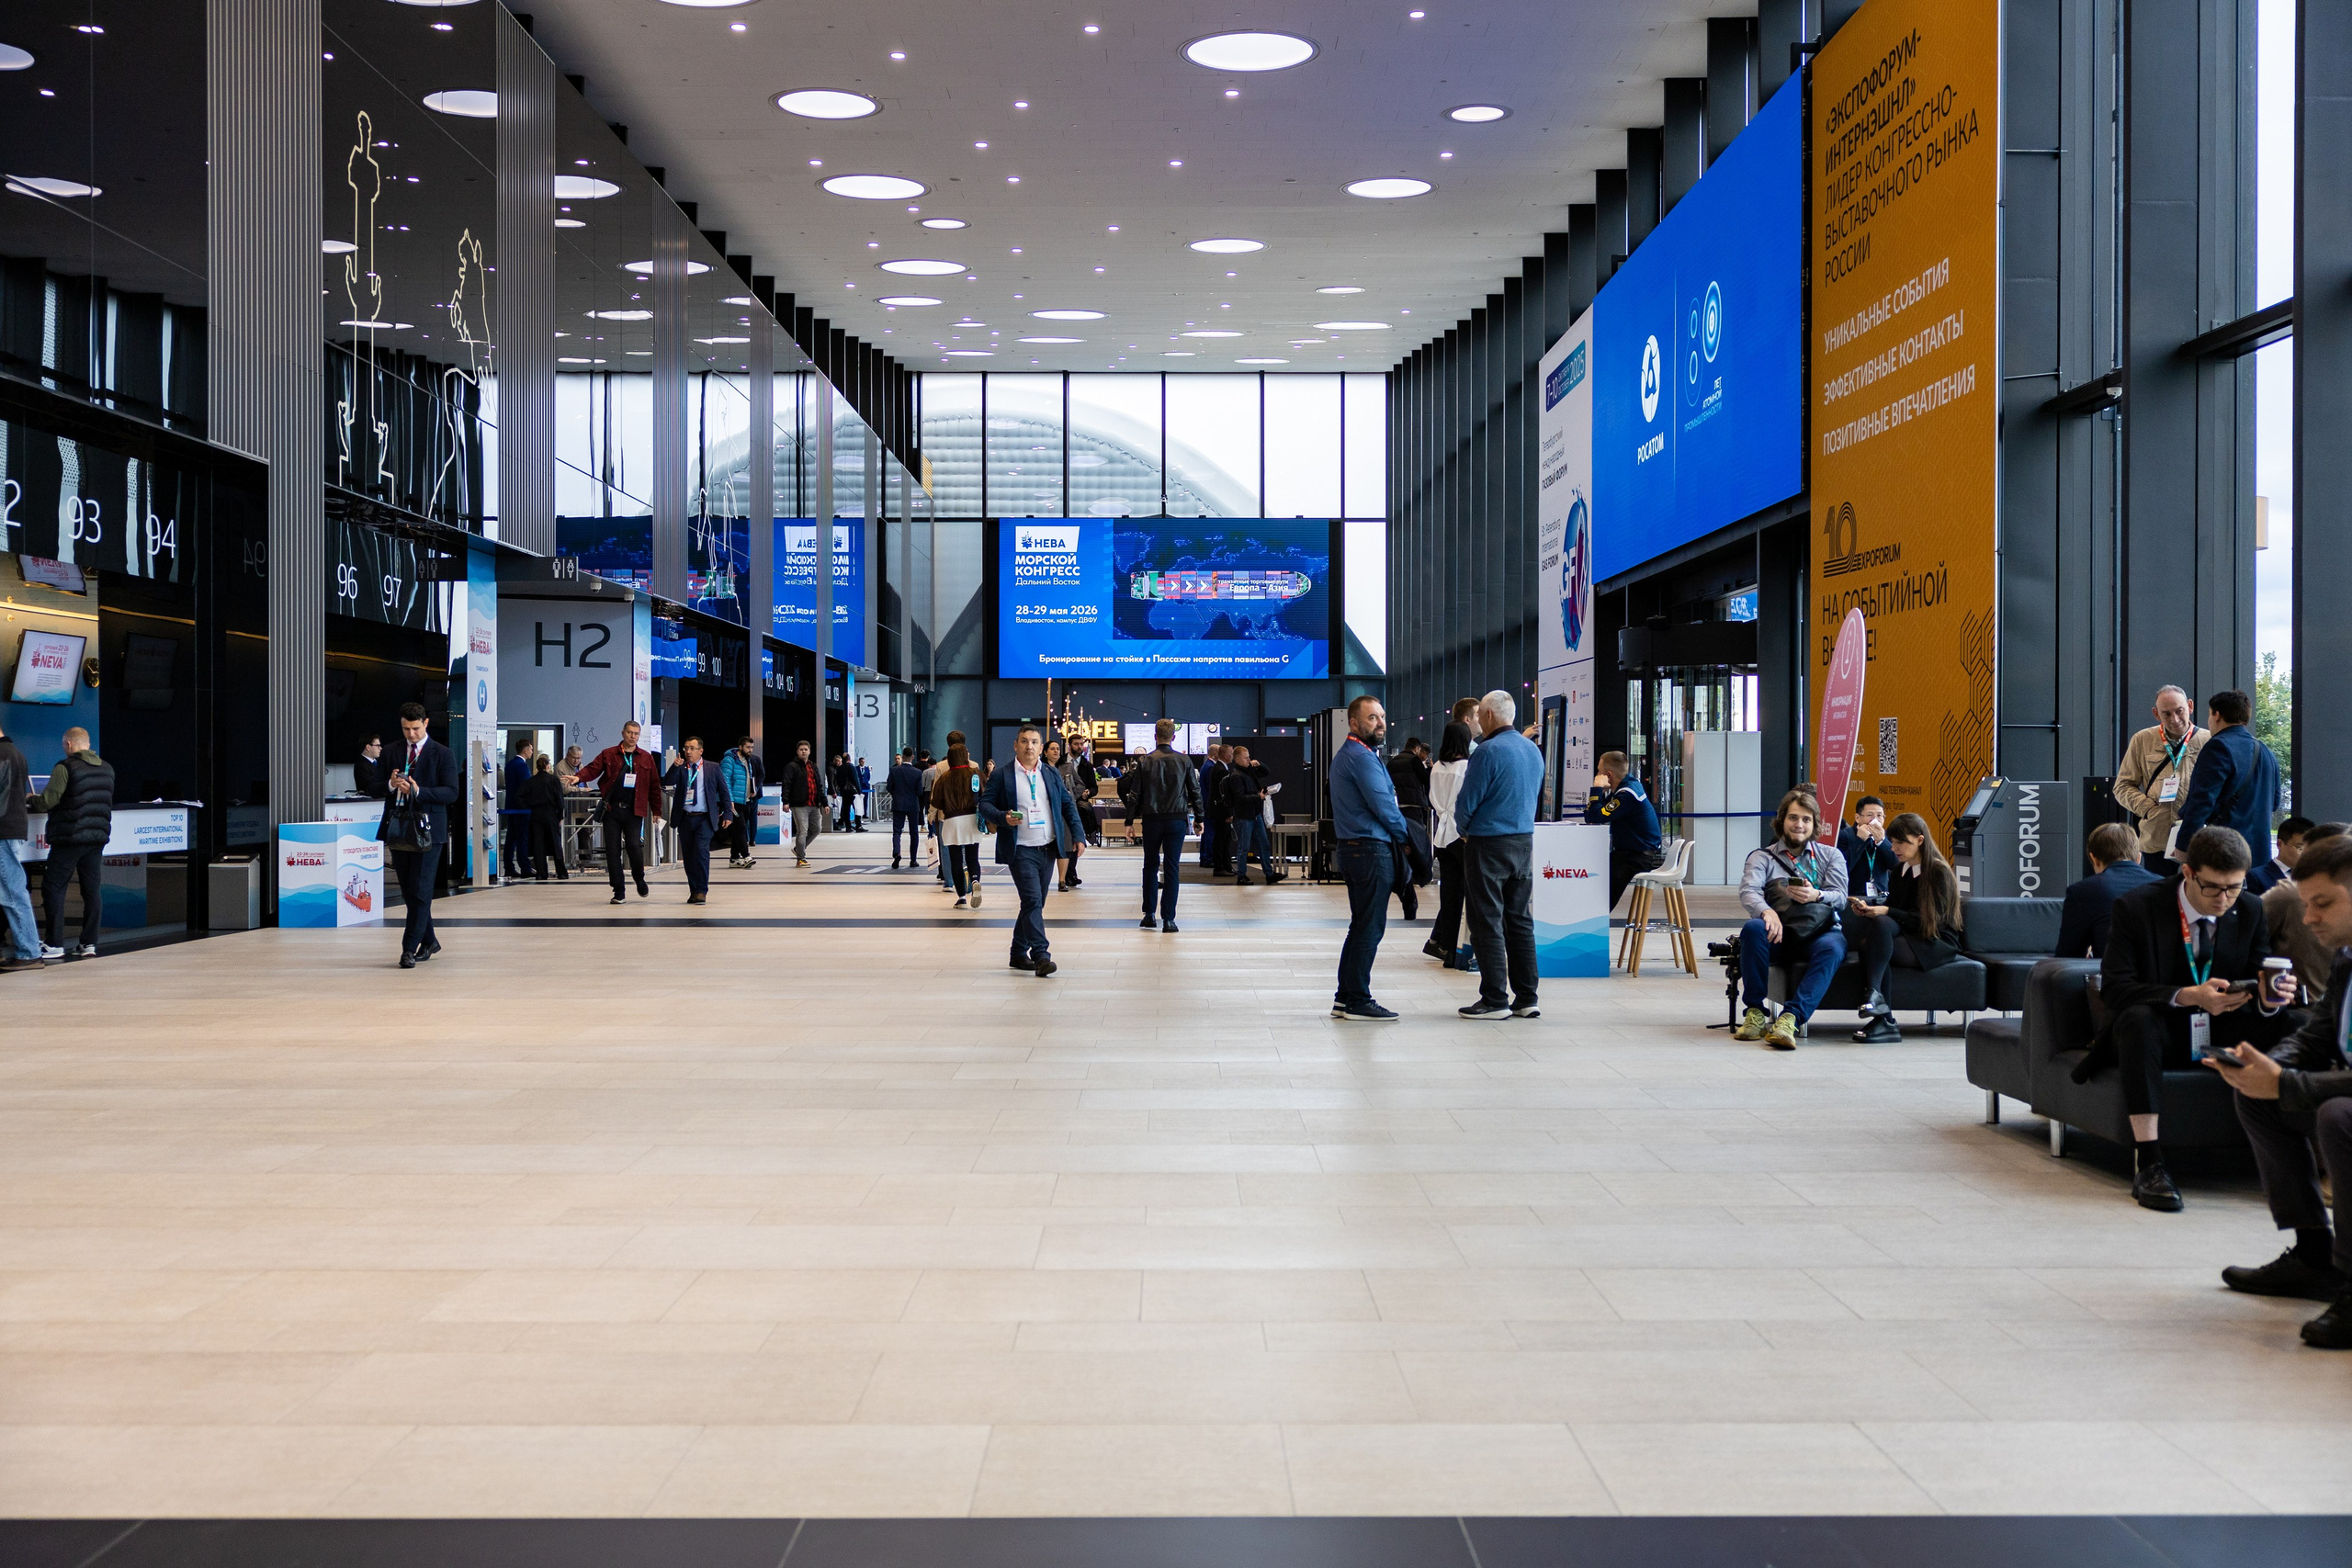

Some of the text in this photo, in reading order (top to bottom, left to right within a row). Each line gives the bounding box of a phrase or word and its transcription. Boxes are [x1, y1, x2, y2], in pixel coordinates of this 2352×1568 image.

[1825, 28, 1922, 134] «ЭКСПОФОРУМ-
[1825, 76, 1917, 176] ИНТЕРНЭШНЛ»
[1825, 85, 1958, 215] ЛИДЕР КОНГРЕССНО-
[1825, 107, 1979, 251] ВЫСТАВОЧНОГО РЫНКА
[1825, 231, 1871, 288] РОССИИ
[1824, 256, 1950, 355] УНИКАЛЬНЫЕ СОБЫТИЯ
[1824, 309, 1964, 405] ЭФФЕКТИВНЫЕ КОНТАКТЫ
[1546, 350, 1585, 406] 7-10 2025
[1713, 377, 1723, 390] ЛЕТ
[1702, 388, 1723, 411] АТОМНОЙ
[1823, 363, 1975, 457] ПОЗИТИВНЫЕ ВПЕЧАТЛЕНИЯ
[1683, 400, 1723, 434] ПРОМЫШЛЕННОСТИ
[1637, 431, 1665, 466] РОСАТОМ
[4, 479, 22, 528] 2
[66, 495, 102, 544] 93
[145, 513, 176, 558] 94
[1035, 539, 1066, 548] НЕВА
[1015, 553, 1076, 566] МОРСКОЙ
[1547, 553, 1559, 569] FORUM
[1853, 542, 1902, 571] EXPOFORUM
[337, 563, 357, 599] 96
[1015, 566, 1080, 576] КОНГРЕСС
[1015, 577, 1051, 586] Дальний
[383, 574, 401, 608] 97
[1229, 584, 1260, 592] Европа
[1823, 559, 1948, 626] НА СОБЫТИЙНОЙ
[1016, 606, 1047, 615] 28-29
[1070, 606, 1098, 615] 2026
[536, 621, 612, 669] H2
[40, 654, 62, 670] NEVA
[698, 652, 706, 672] 99
[712, 657, 721, 676] 100
[1039, 655, 1101, 664] Бронирование
[1153, 655, 1191, 663] Пассаже
[1282, 655, 1289, 663] G
[765, 671, 774, 688] 103
[1061, 721, 1118, 739] CAFE
[1855, 743, 1865, 756] ЕСЬ
[1849, 780, 1865, 792] um.ru
[134, 825, 184, 835] LARGEST INTERNATIONAL
[139, 836, 184, 845] MARITIME EXHIBITIONS
[2018, 784, 2041, 897] OFORUM
[1556, 869, 1589, 878] NEVA
